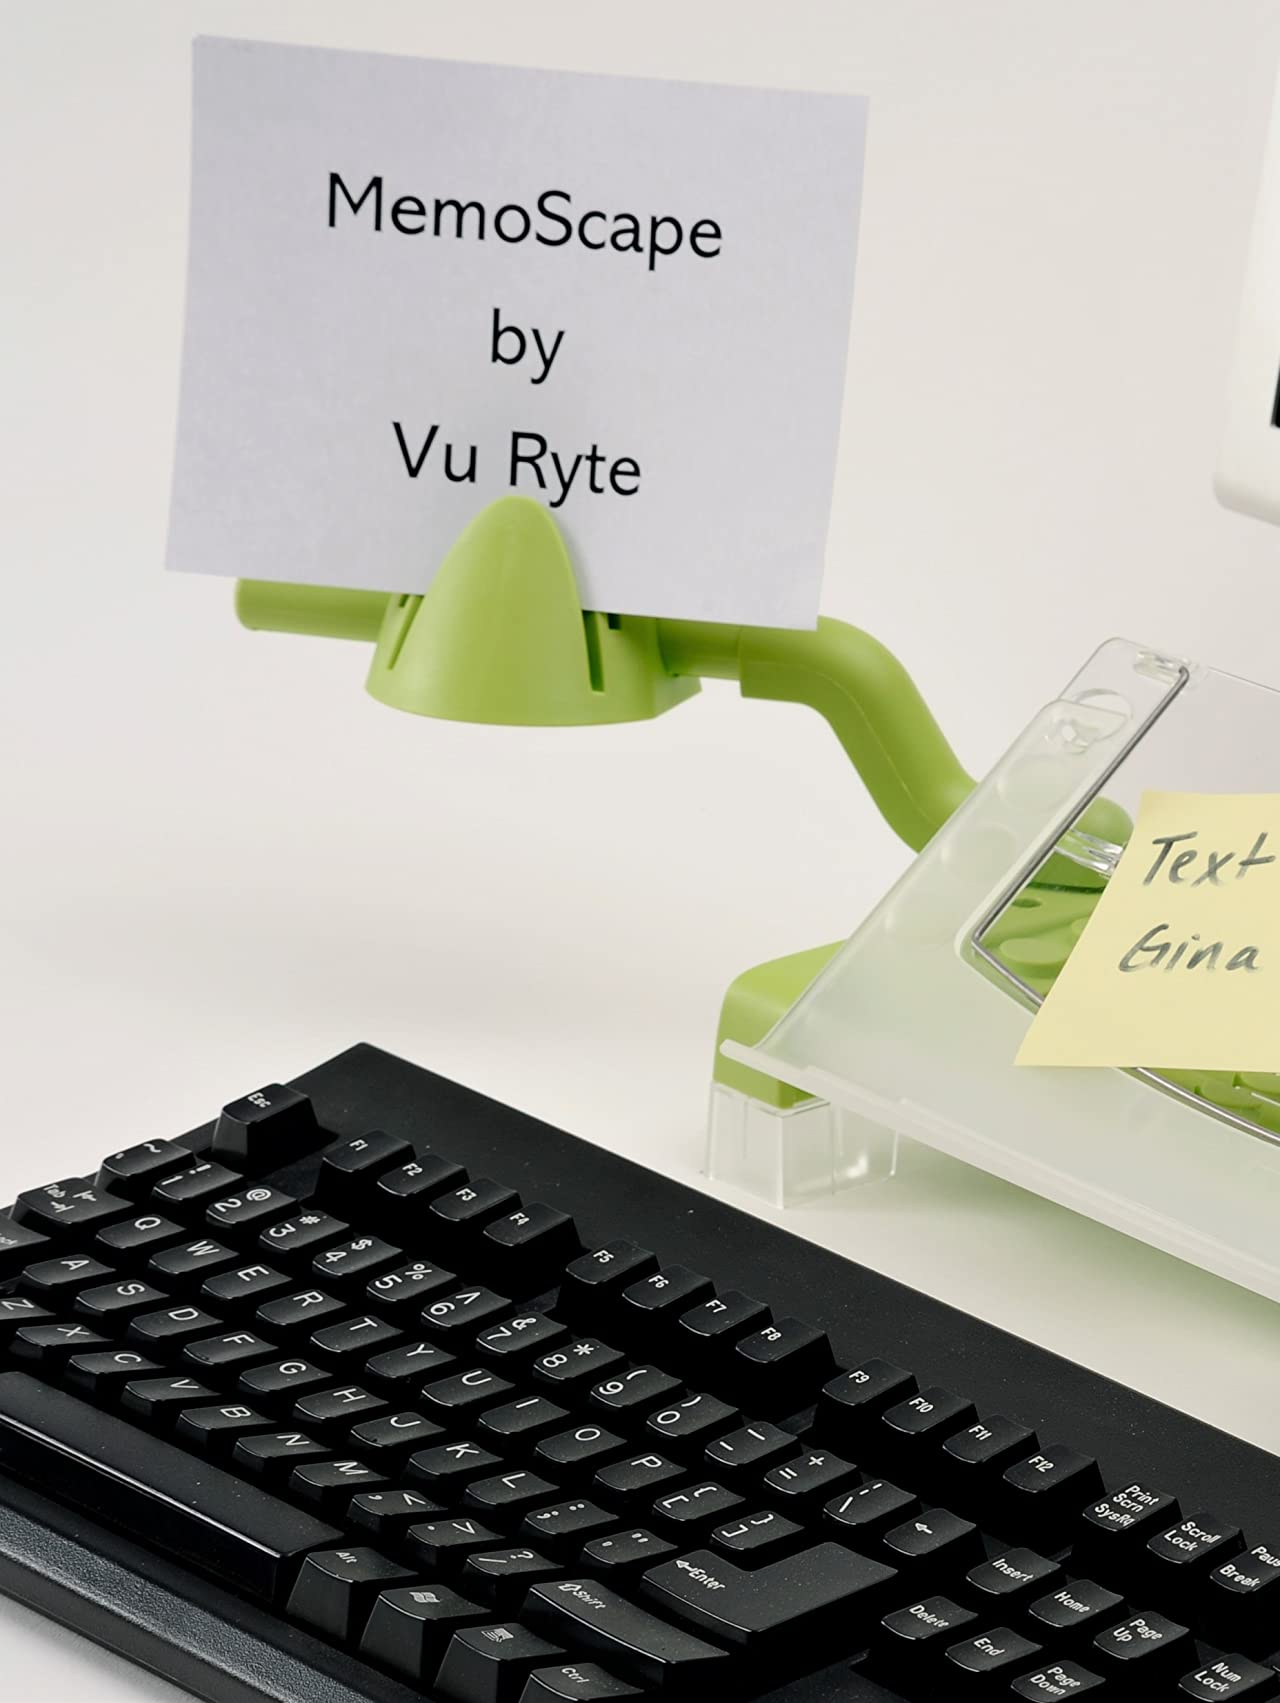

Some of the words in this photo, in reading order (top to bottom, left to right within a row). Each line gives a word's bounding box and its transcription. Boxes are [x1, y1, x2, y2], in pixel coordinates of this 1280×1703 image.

[329, 173, 721, 271] MemoScape
[492, 308, 564, 384] by
[393, 422, 477, 483] Vu
[510, 431, 641, 508] Ryte
[1143, 831, 1275, 886] Text
[248, 1092, 271, 1107] Esc
[350, 1139, 368, 1151] F1
[402, 1163, 423, 1176] F2
[161, 1176, 183, 1185] 1
[43, 1184, 66, 1198] Tab
[456, 1188, 477, 1201] F3
[214, 1198, 242, 1212] 2
[134, 1217, 161, 1230] Q
[510, 1213, 529, 1225] F4
[269, 1223, 296, 1237] 3
[187, 1241, 219, 1256] W
[325, 1252, 347, 1263] 4
[593, 1250, 614, 1263] F5
[61, 1260, 89, 1270] A
[237, 1266, 269, 1281] E
[375, 1274, 402, 1289] 5
[648, 1275, 669, 1288] F6
[117, 1284, 145, 1295] S
[1, 1299, 34, 1310] Z
[293, 1291, 323, 1307] R
[705, 1299, 727, 1312] F7
[168, 1308, 199, 1320] D
[430, 1302, 455, 1315] 6
[350, 1317, 377, 1330] T
[57, 1327, 90, 1337] X
[223, 1334, 255, 1343] F
[487, 1326, 512, 1340] 7
[761, 1327, 781, 1341] F8
[407, 1344, 434, 1356] Y
[114, 1354, 141, 1363] C
[543, 1354, 567, 1367] 8
[279, 1362, 306, 1374] G
[170, 1379, 199, 1388] V
[462, 1371, 492, 1385] U
[849, 1371, 869, 1383] F9
[333, 1388, 366, 1402] H
[599, 1381, 624, 1395] 9
[909, 1397, 933, 1412] F10
[220, 1407, 251, 1418] B
[657, 1411, 680, 1424] 0
[390, 1417, 421, 1427] J
[277, 1434, 310, 1445] N
[575, 1428, 600, 1441] O
[968, 1425, 992, 1440] F11
[446, 1443, 479, 1458] K
[334, 1462, 368, 1475] M
[631, 1456, 662, 1467] P
[1028, 1456, 1054, 1472] F12
[502, 1473, 526, 1488] L
[1125, 1485, 1160, 1505] Print
[1112, 1493, 1144, 1512] Scrn
[1181, 1521, 1222, 1543] Scroll
[1164, 1530, 1198, 1552] Lock
[336, 1552, 357, 1563] Alt
[992, 1559, 1033, 1581] Insert
[1220, 1564, 1260, 1587] Break
[689, 1568, 726, 1590] Enter
[572, 1590, 606, 1609] Shift
[1054, 1591, 1090, 1612] Home
[909, 1605, 949, 1627] Delete
[1113, 1627, 1132, 1641] Up
[1129, 1619, 1162, 1639] Page
[974, 1638, 1005, 1656] End
[562, 1668, 589, 1682] Ctrl
[1047, 1667, 1080, 1687] Page
[1211, 1662, 1241, 1682] Num
[1030, 1674, 1066, 1695] Down
[1194, 1670, 1229, 1692] Lock
